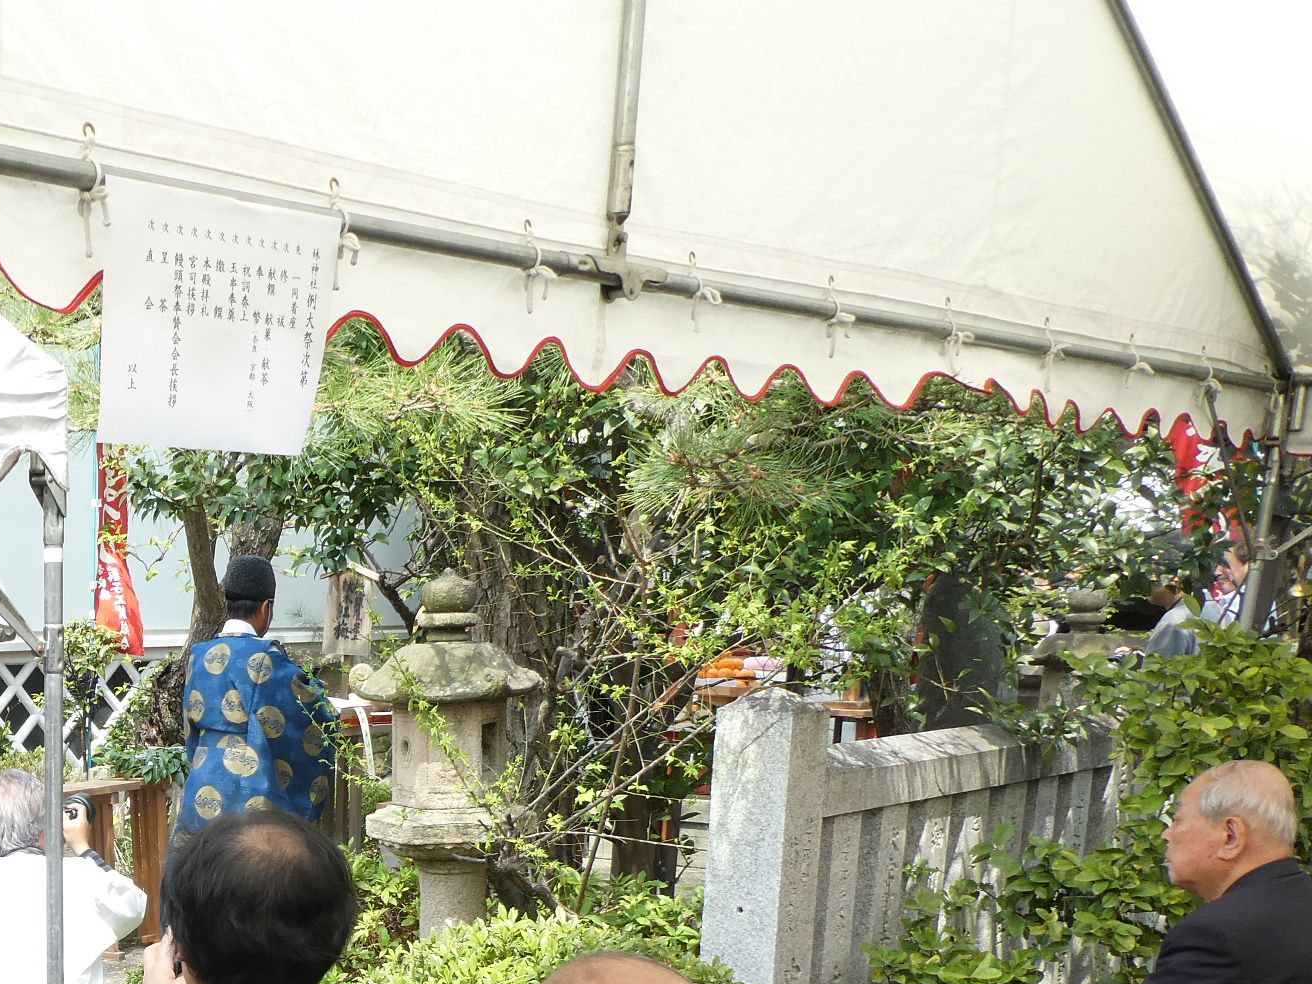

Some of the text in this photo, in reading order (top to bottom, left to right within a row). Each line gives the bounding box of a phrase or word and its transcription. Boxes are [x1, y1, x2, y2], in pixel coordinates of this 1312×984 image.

[144, 248, 154, 310] 直会
[158, 251, 169, 313] 呈茶
[186, 255, 198, 317] 宮司挨拶
[200, 256, 212, 317] 本殿拝礼
[227, 262, 238, 322] 玉串奉奠
[240, 264, 252, 322] 祝詞奏上
[288, 276, 300, 329] 一同着座
[168, 252, 184, 408] 饅頭祭奉賛会会長挨拶
[128, 364, 138, 390] 以上
